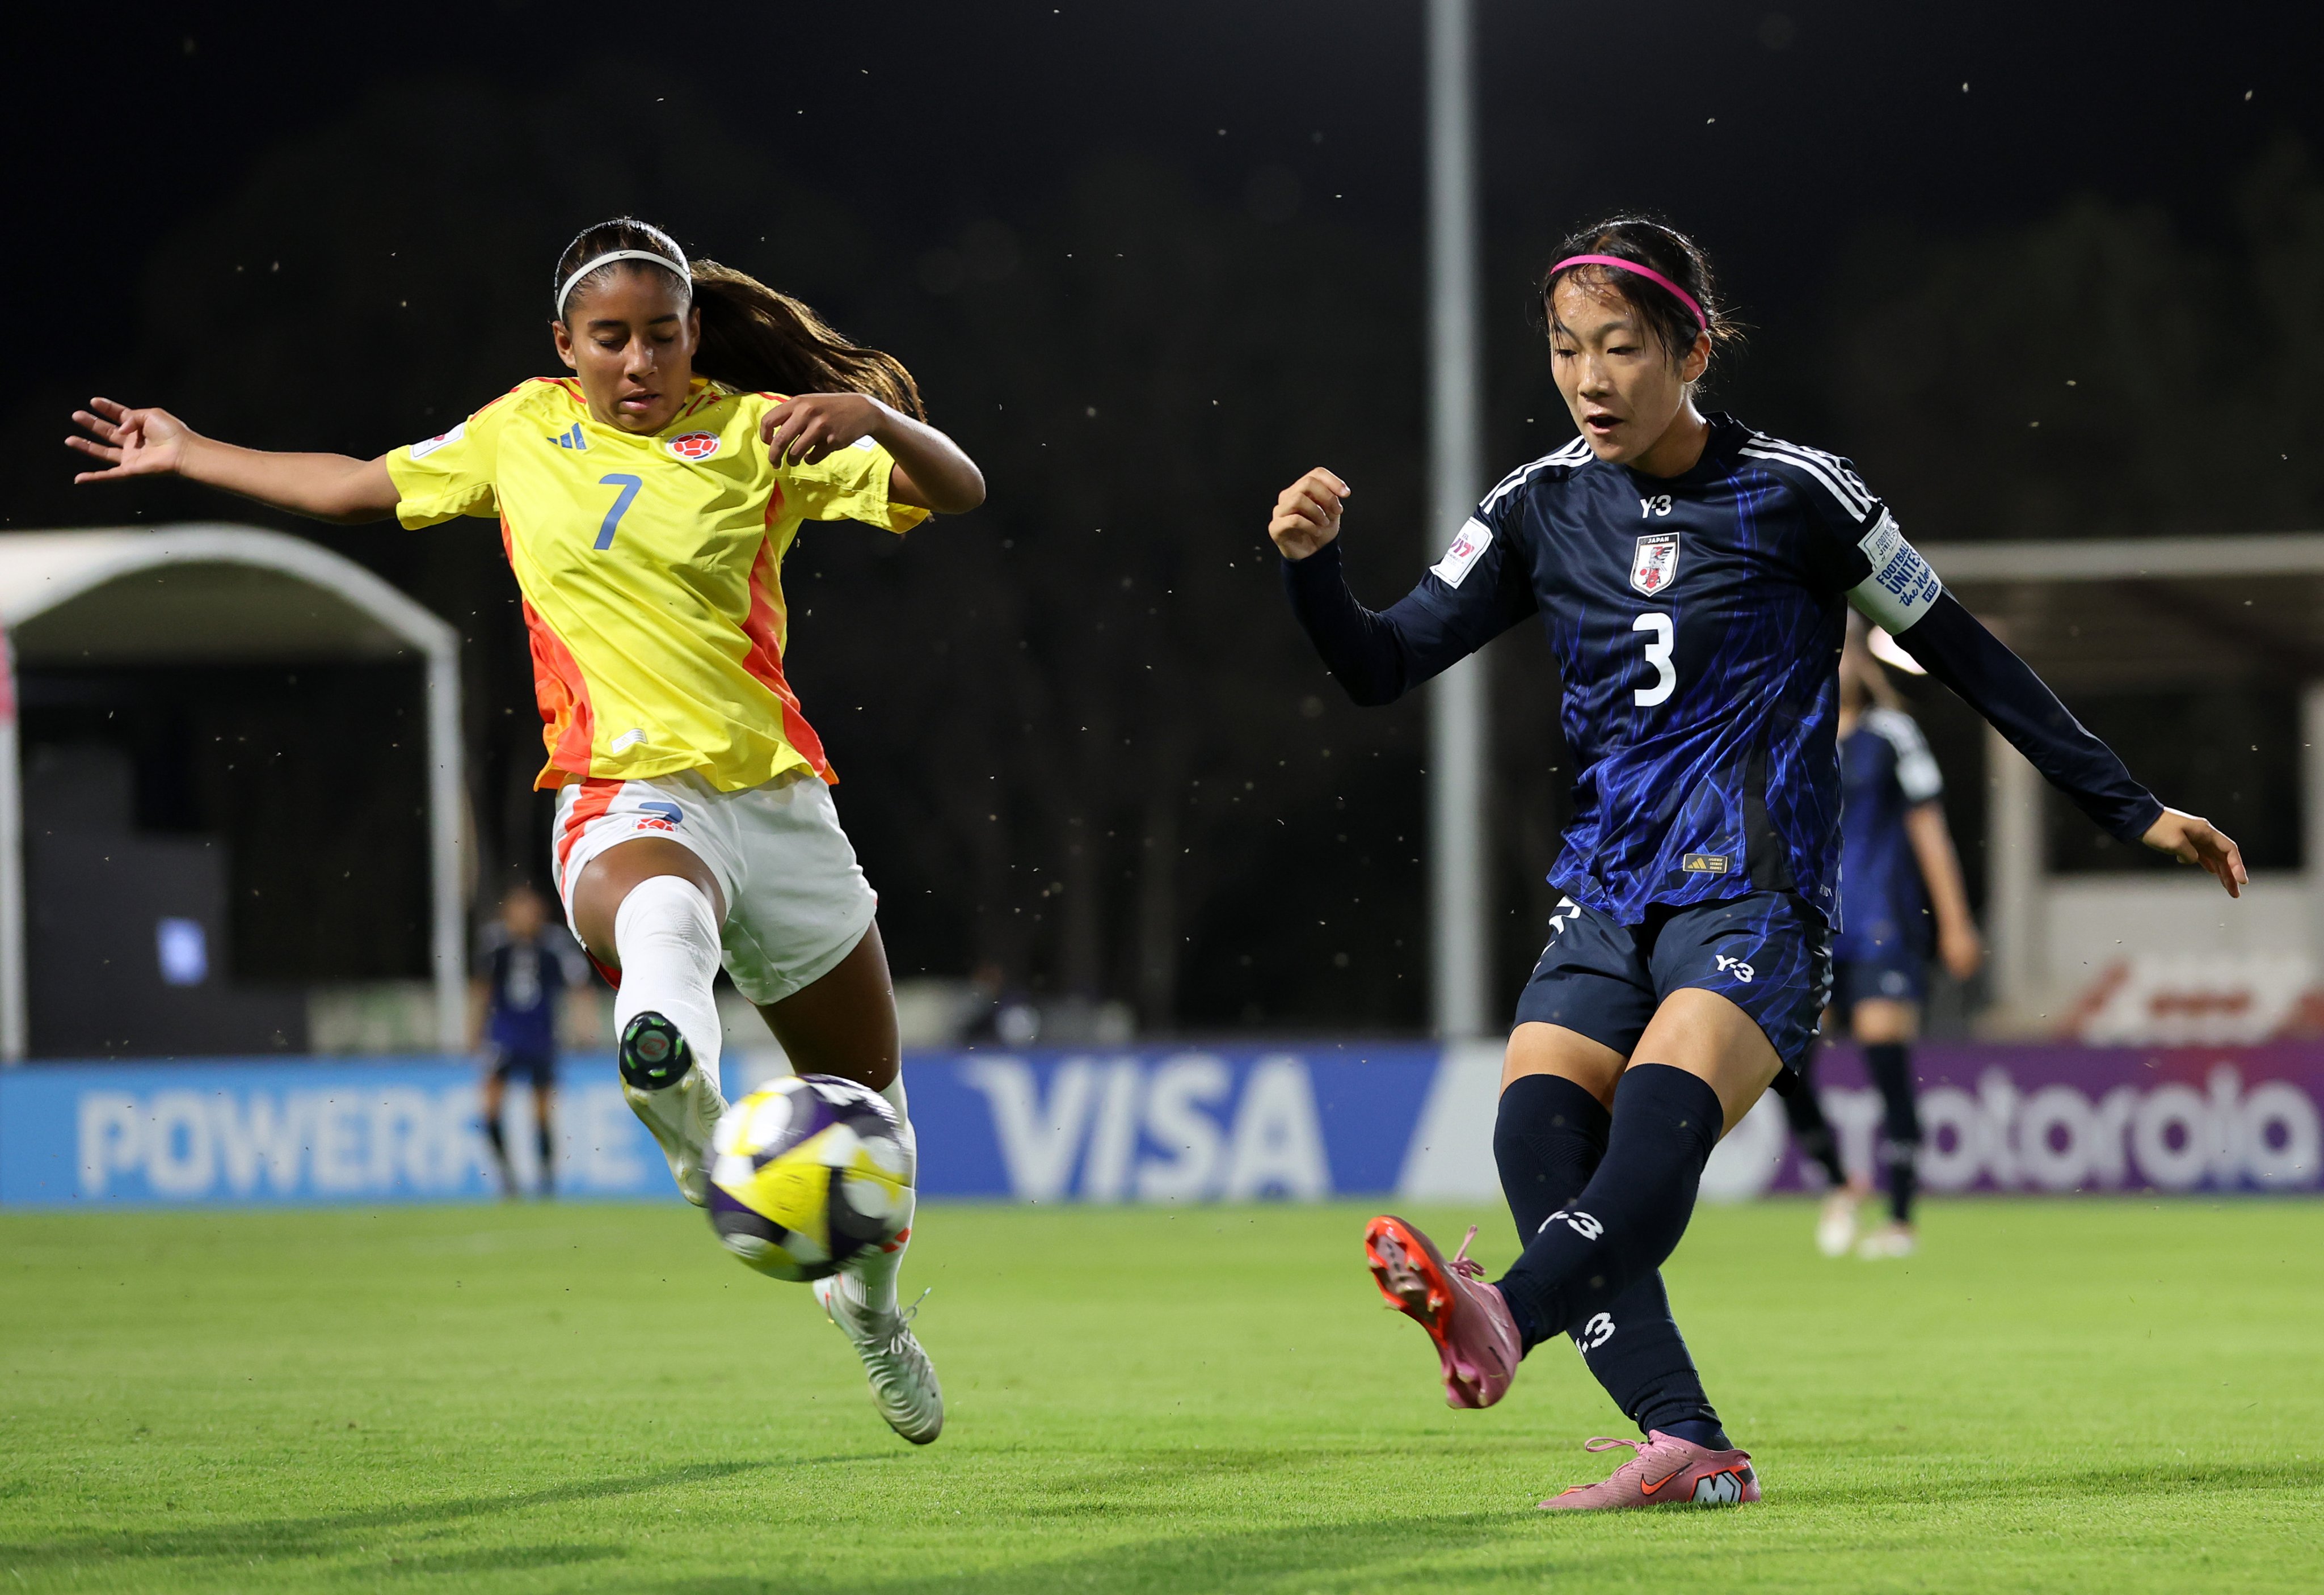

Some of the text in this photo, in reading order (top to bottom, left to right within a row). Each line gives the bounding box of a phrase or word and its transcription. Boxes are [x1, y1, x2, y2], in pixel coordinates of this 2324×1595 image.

[593, 474, 642, 550] 7
[1640, 495, 1672, 518] Y-3
[1875, 540, 1909, 585] FOOTBALL
[1885, 548, 1921, 594] UNITES
[1899, 588, 1918, 606] the
[1924, 583, 1938, 601] FIFA
[1632, 613, 1676, 707] 3
[1716, 955, 1754, 983] Y-3
[961, 1054, 1335, 1205] VISA
